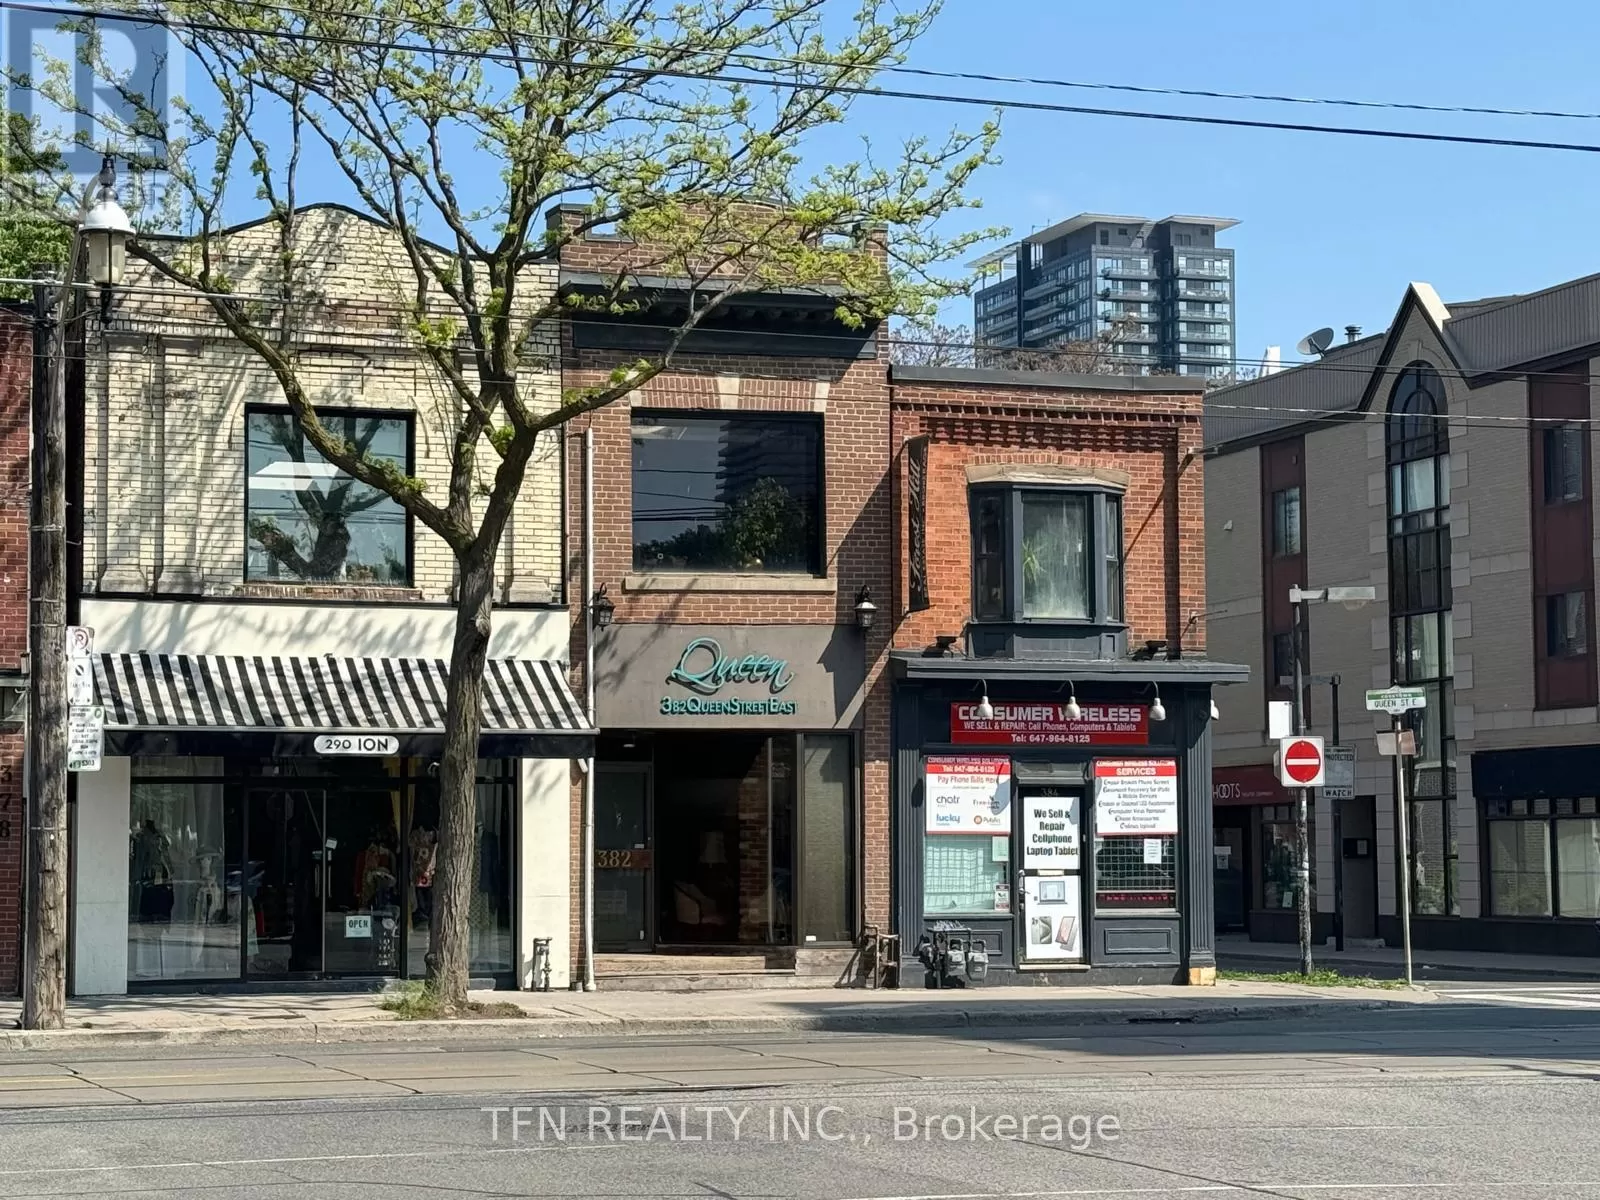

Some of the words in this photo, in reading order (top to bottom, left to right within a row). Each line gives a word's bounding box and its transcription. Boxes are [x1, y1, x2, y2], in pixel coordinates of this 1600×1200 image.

[909, 456, 920, 511] Hill
[909, 516, 921, 592] Forest
[670, 637, 795, 691] Queen
[1374, 700, 1397, 708] QUEEN
[1070, 723, 1105, 732] Computers
[1114, 723, 1136, 731] Tablets
[1011, 734, 1026, 742] Tel:
[326, 739, 351, 749] 290
[358, 738, 388, 751] ION
[1116, 767, 1156, 776] SERVICES
[937, 775, 949, 784] Pay
[950, 775, 969, 783] Phone
[1325, 789, 1352, 797] WATCH
[936, 813, 960, 823] lucky
[1034, 809, 1047, 818] We
[1048, 809, 1063, 818] Sell
[1040, 821, 1065, 831] Repair
[1032, 833, 1072, 844] Cellphone
[1027, 846, 1053, 856] Laptop
[1054, 846, 1079, 855] Tablet
[598, 850, 632, 868] 382
[348, 919, 368, 929] OPEN
